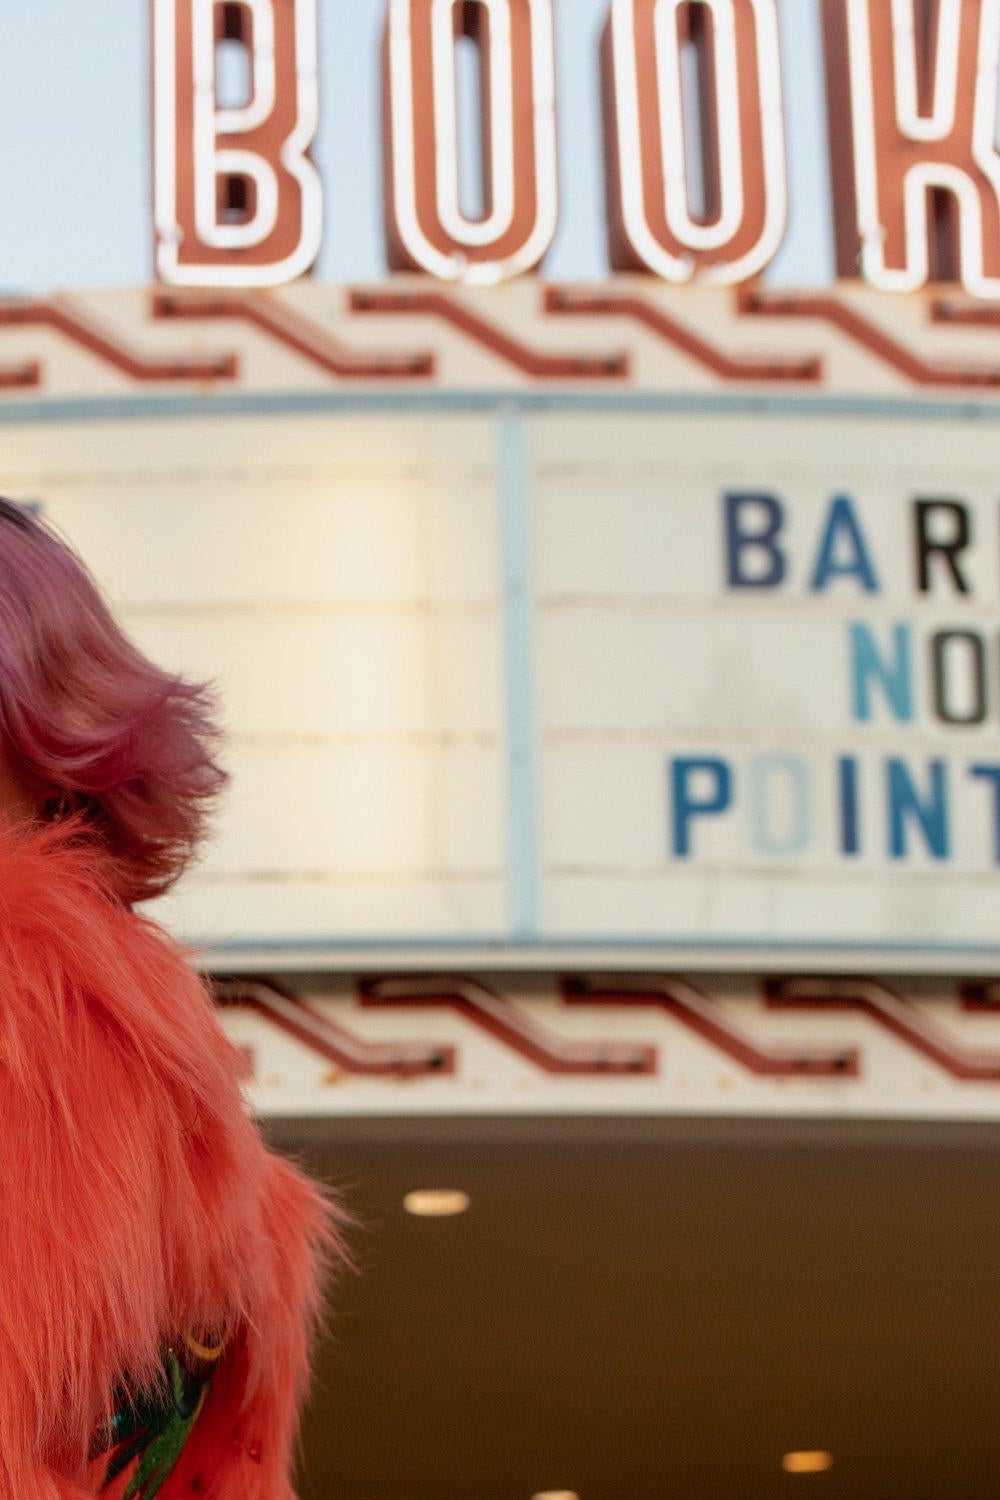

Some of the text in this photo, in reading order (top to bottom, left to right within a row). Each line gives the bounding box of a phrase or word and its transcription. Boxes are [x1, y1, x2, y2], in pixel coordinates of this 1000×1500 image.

[152, 0, 1000, 299] BOOK
[721, 489, 1000, 597] BAR
[847, 622, 1000, 727] NO
